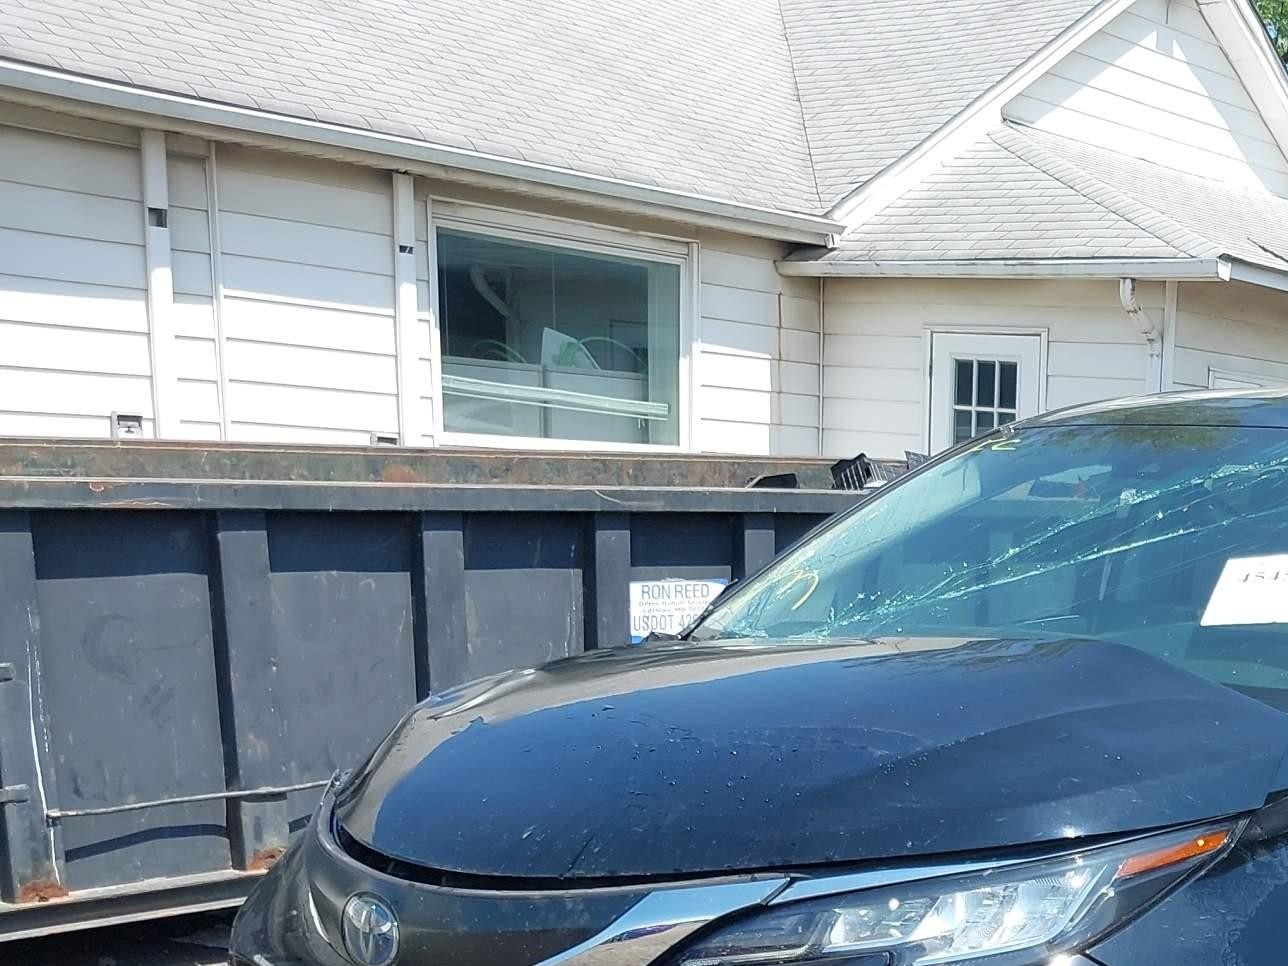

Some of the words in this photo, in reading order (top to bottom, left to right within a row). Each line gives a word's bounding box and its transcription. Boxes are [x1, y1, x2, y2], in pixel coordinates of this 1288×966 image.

[641, 584, 671, 600] RON
[674, 583, 710, 599] REED
[633, 614, 675, 632] USDOT
